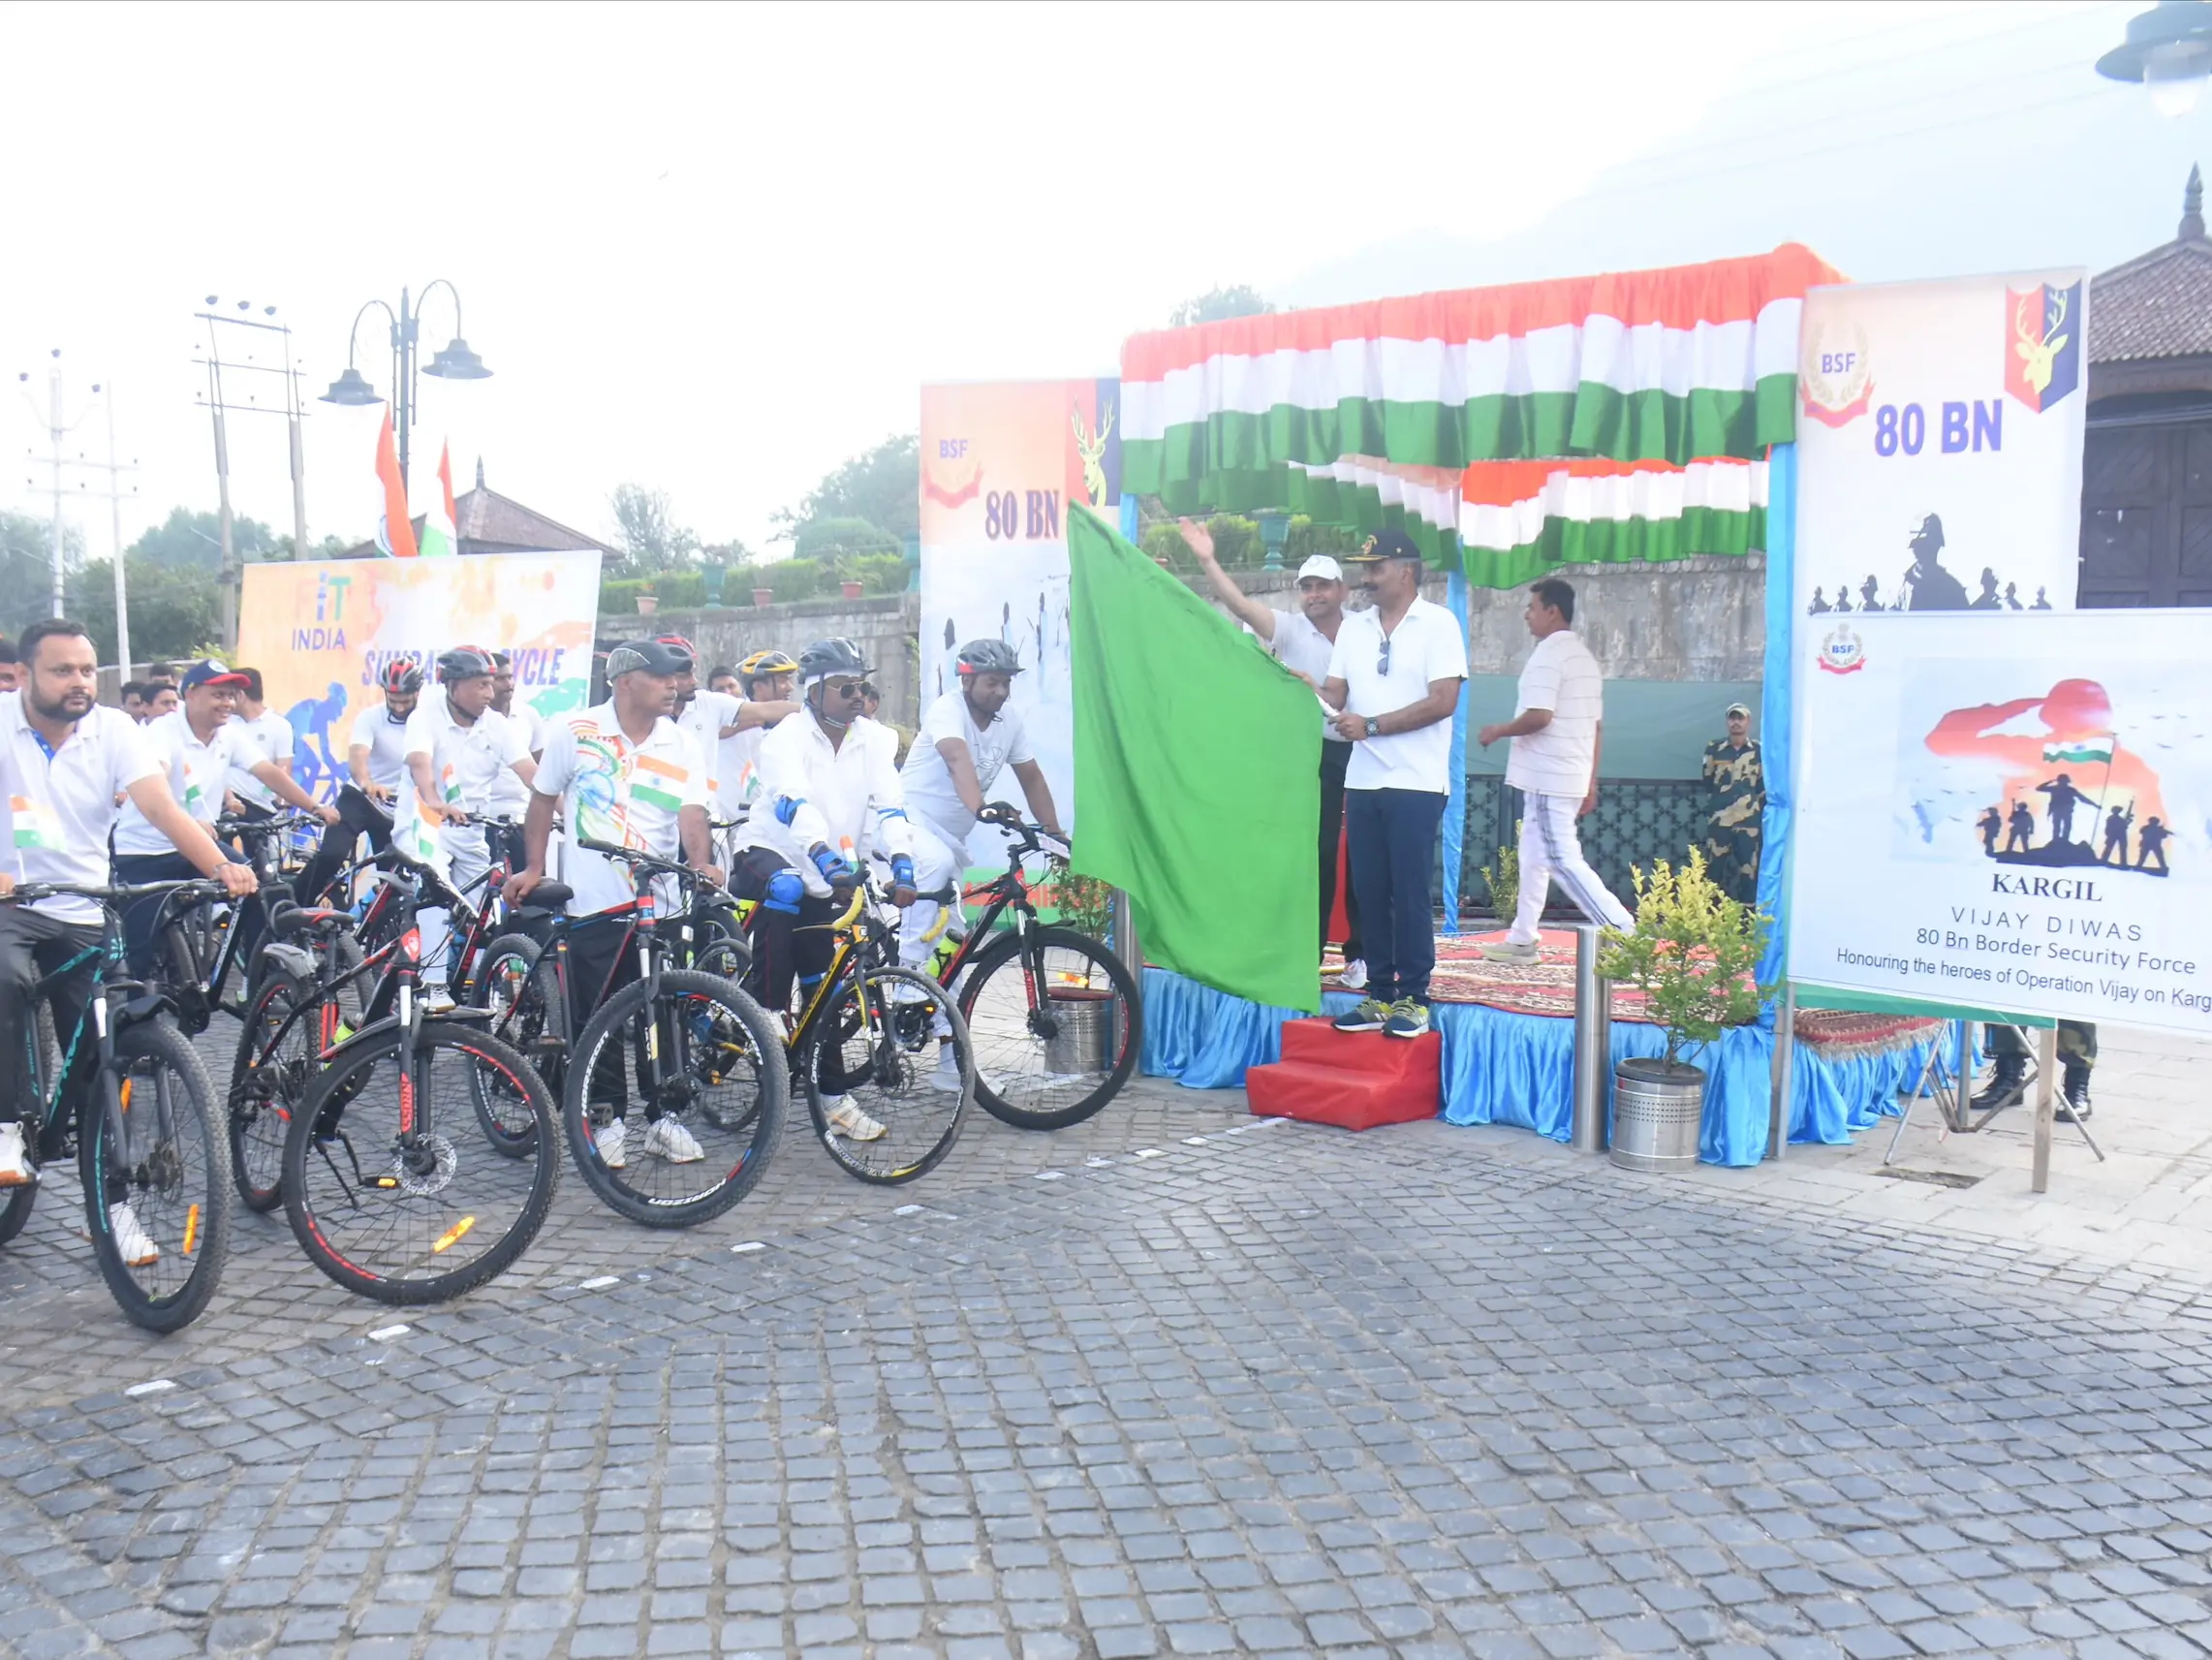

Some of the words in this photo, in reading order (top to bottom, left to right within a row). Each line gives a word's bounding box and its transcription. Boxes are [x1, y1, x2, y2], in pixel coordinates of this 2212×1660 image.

[1822, 353, 1855, 373] BSF
[1874, 402, 1925, 457] 80
[1941, 398, 2003, 454] BN
[939, 438, 968, 458] BSF
[985, 490, 1018, 541] 80
[1025, 489, 1059, 540] BN
[292, 627, 346, 651] INDIA
[1831, 644, 1854, 654] BSF
[501, 648, 565, 685] YCLE
[1991, 873, 2103, 902] KARGIL
[1951, 906, 2030, 929] VIJAY
[2046, 916, 2142, 941] DIWAS
[1916, 927, 1940, 945] 80
[1946, 930, 1969, 949] Bn
[1976, 934, 2041, 956] Border
[2047, 942, 2131, 970] Security
[2137, 952, 2196, 975] Force
[1837, 947, 1909, 975] Honouring
[1914, 957, 1936, 975] the
[1941, 960, 1992, 982] heroes
[1996, 968, 2012, 984] of
[2015, 969, 2094, 994] Operation
[2100, 979, 2139, 1003] Vijay
[2144, 988, 2165, 1003] on
[581, 1030, 608, 1117] HORIZON
[647, 1177, 727, 1206] HORIZON
